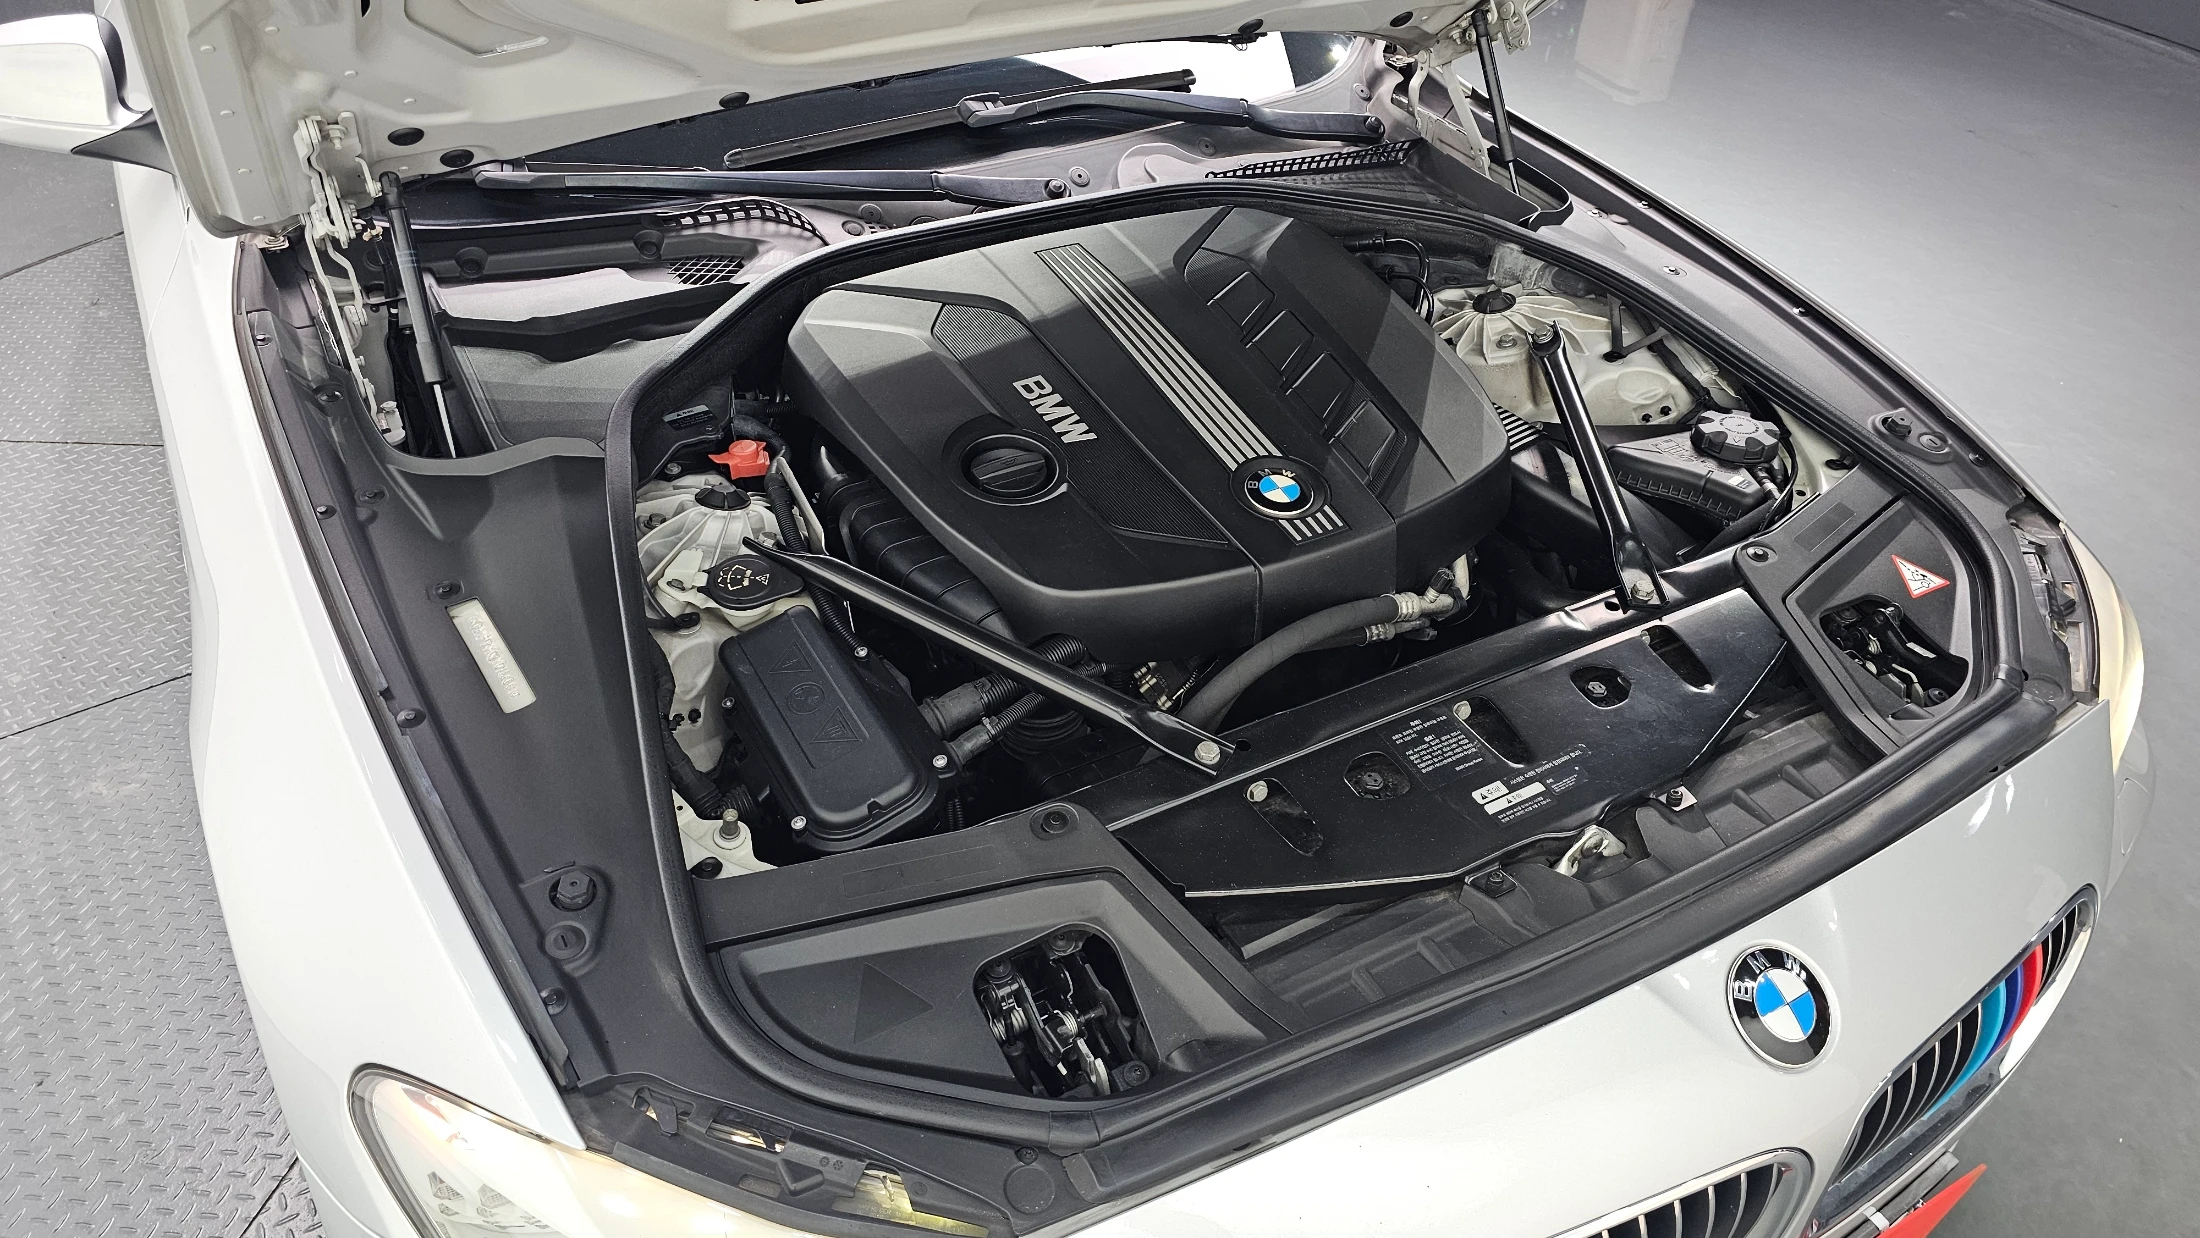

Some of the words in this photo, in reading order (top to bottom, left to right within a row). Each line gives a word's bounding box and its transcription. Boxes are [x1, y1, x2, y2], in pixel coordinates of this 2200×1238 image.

[1012, 374, 1098, 444] BMW
[1247, 468, 1296, 489] BMW
[1733, 950, 1807, 1003] BMW
